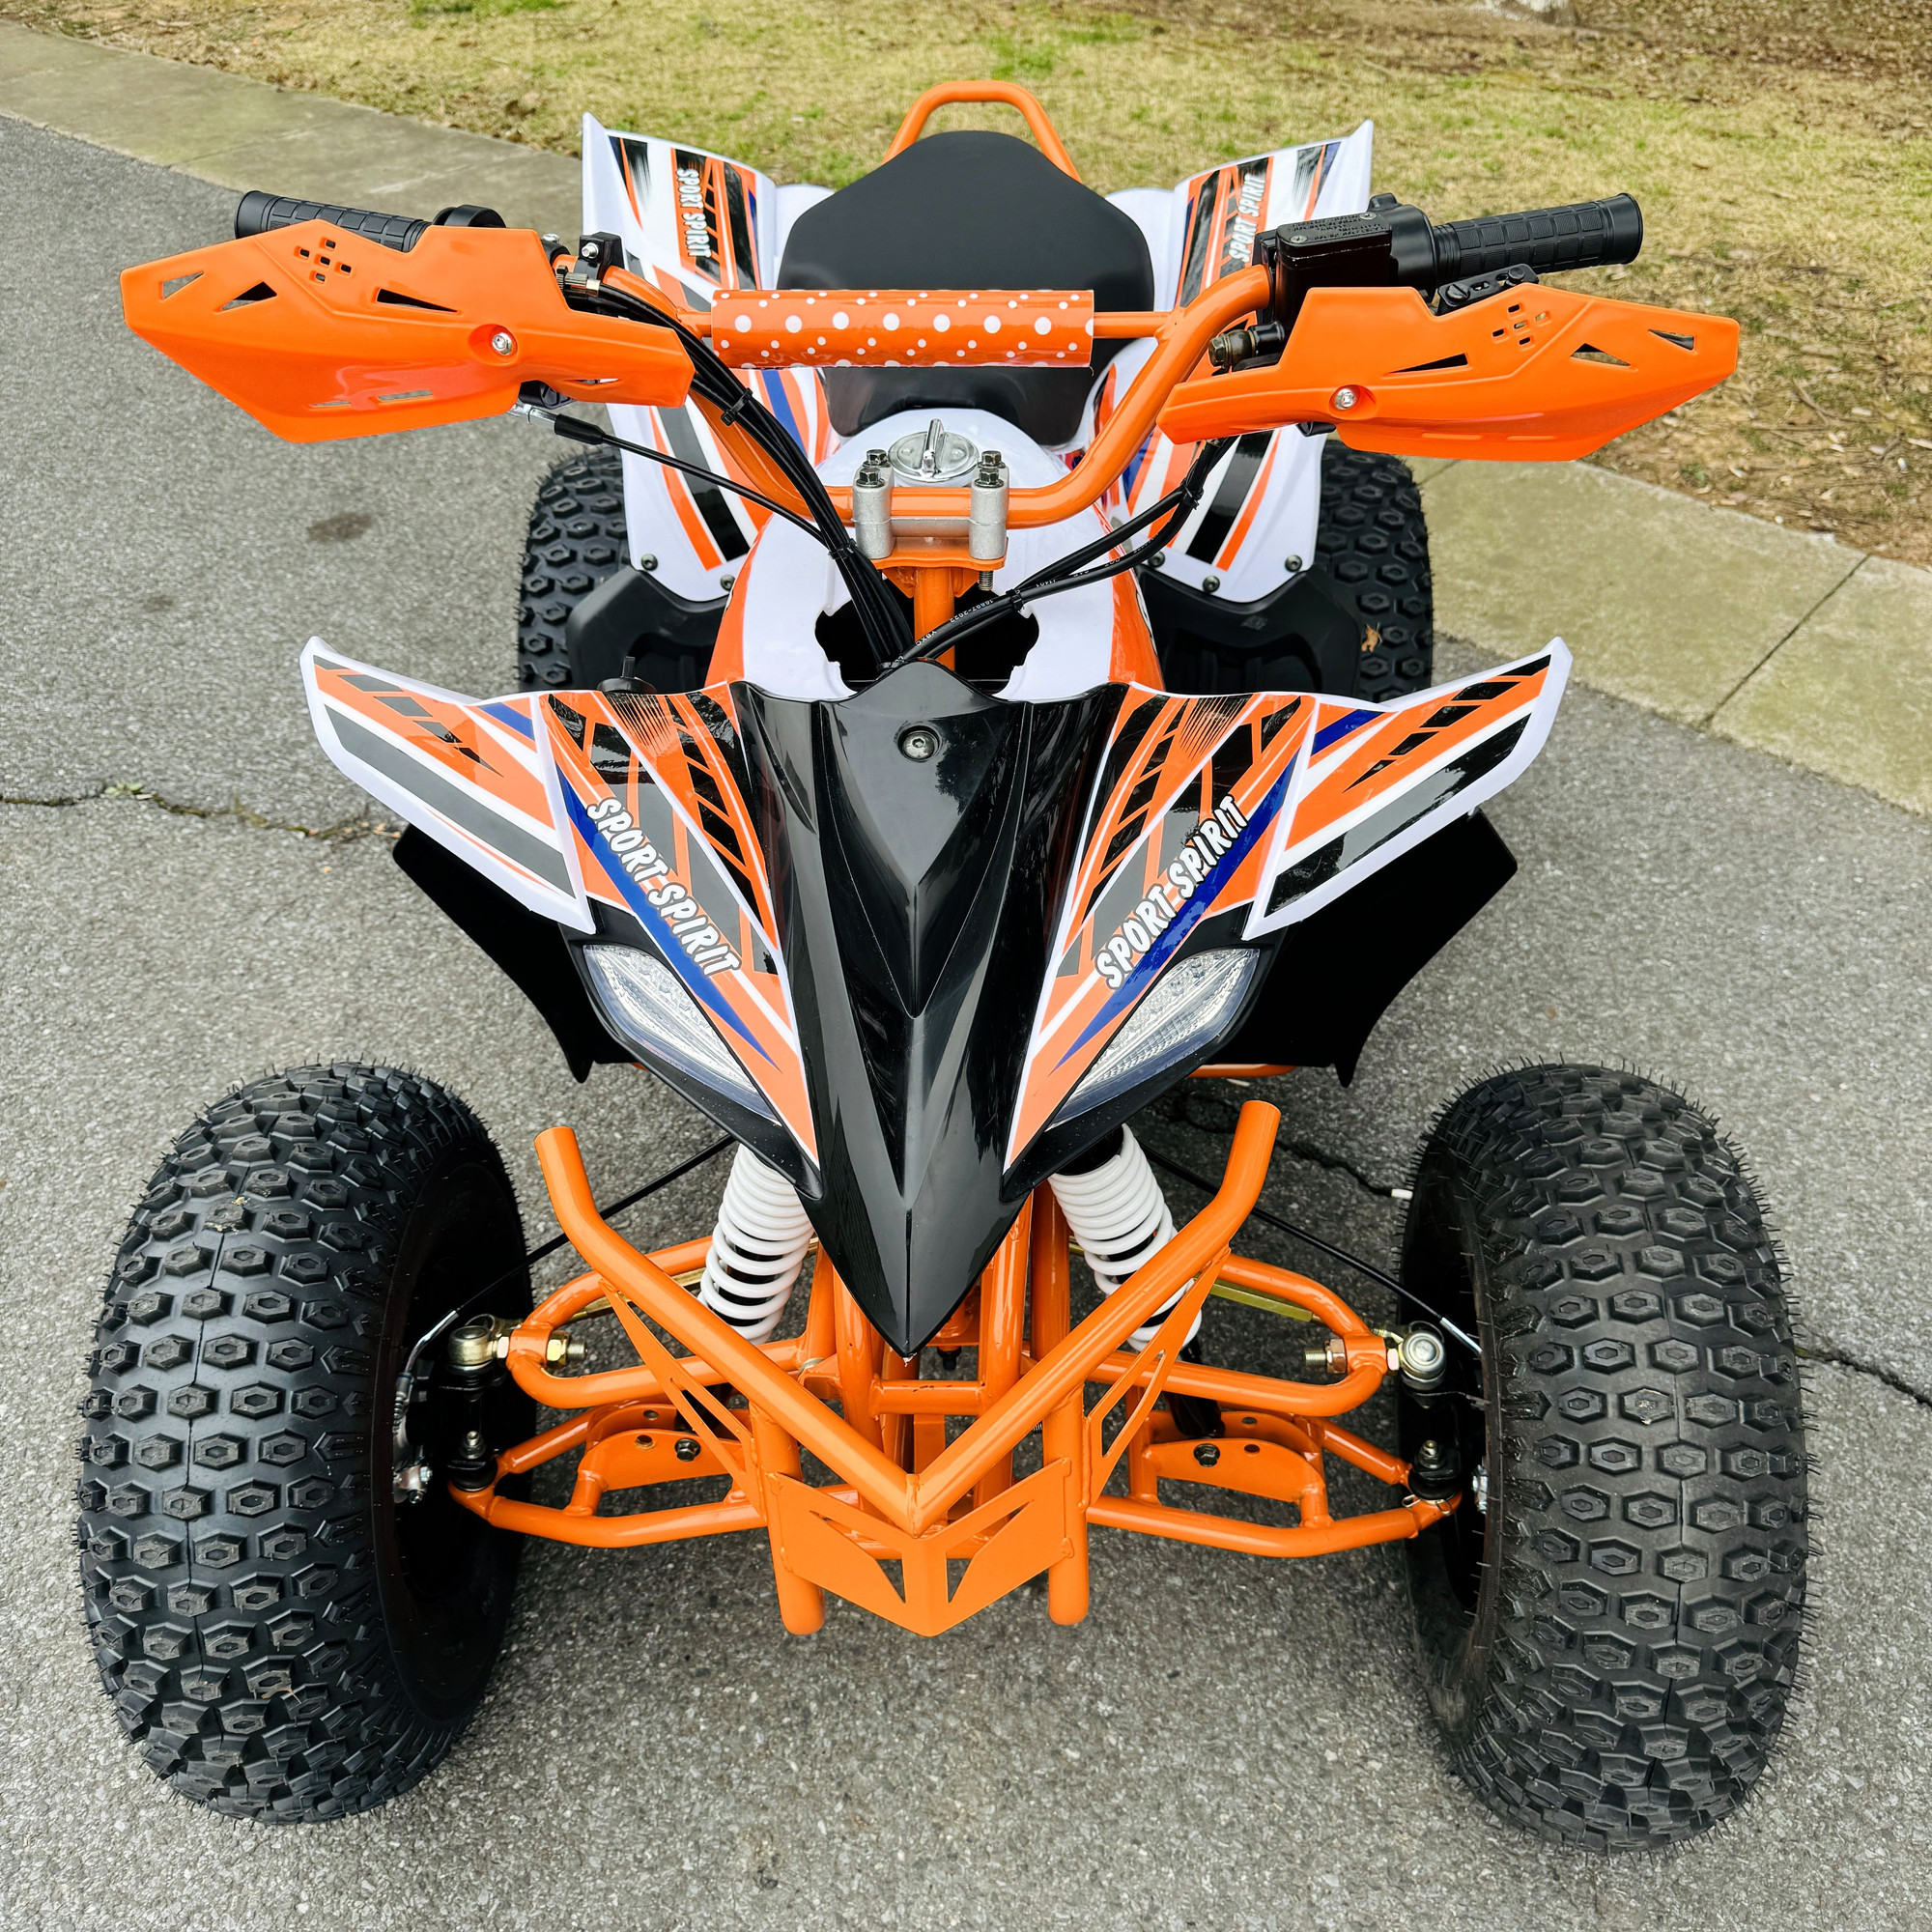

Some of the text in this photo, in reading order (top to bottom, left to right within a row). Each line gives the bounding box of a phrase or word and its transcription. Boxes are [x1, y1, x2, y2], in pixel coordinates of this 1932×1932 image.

[677, 168, 711, 258] SPORT SPIRIT
[1229, 172, 1265, 263] SPORT SPIRIT
[587, 798, 742, 977] SPORT SPIRIT
[1095, 793, 1248, 989] SPORT SPIRIT
